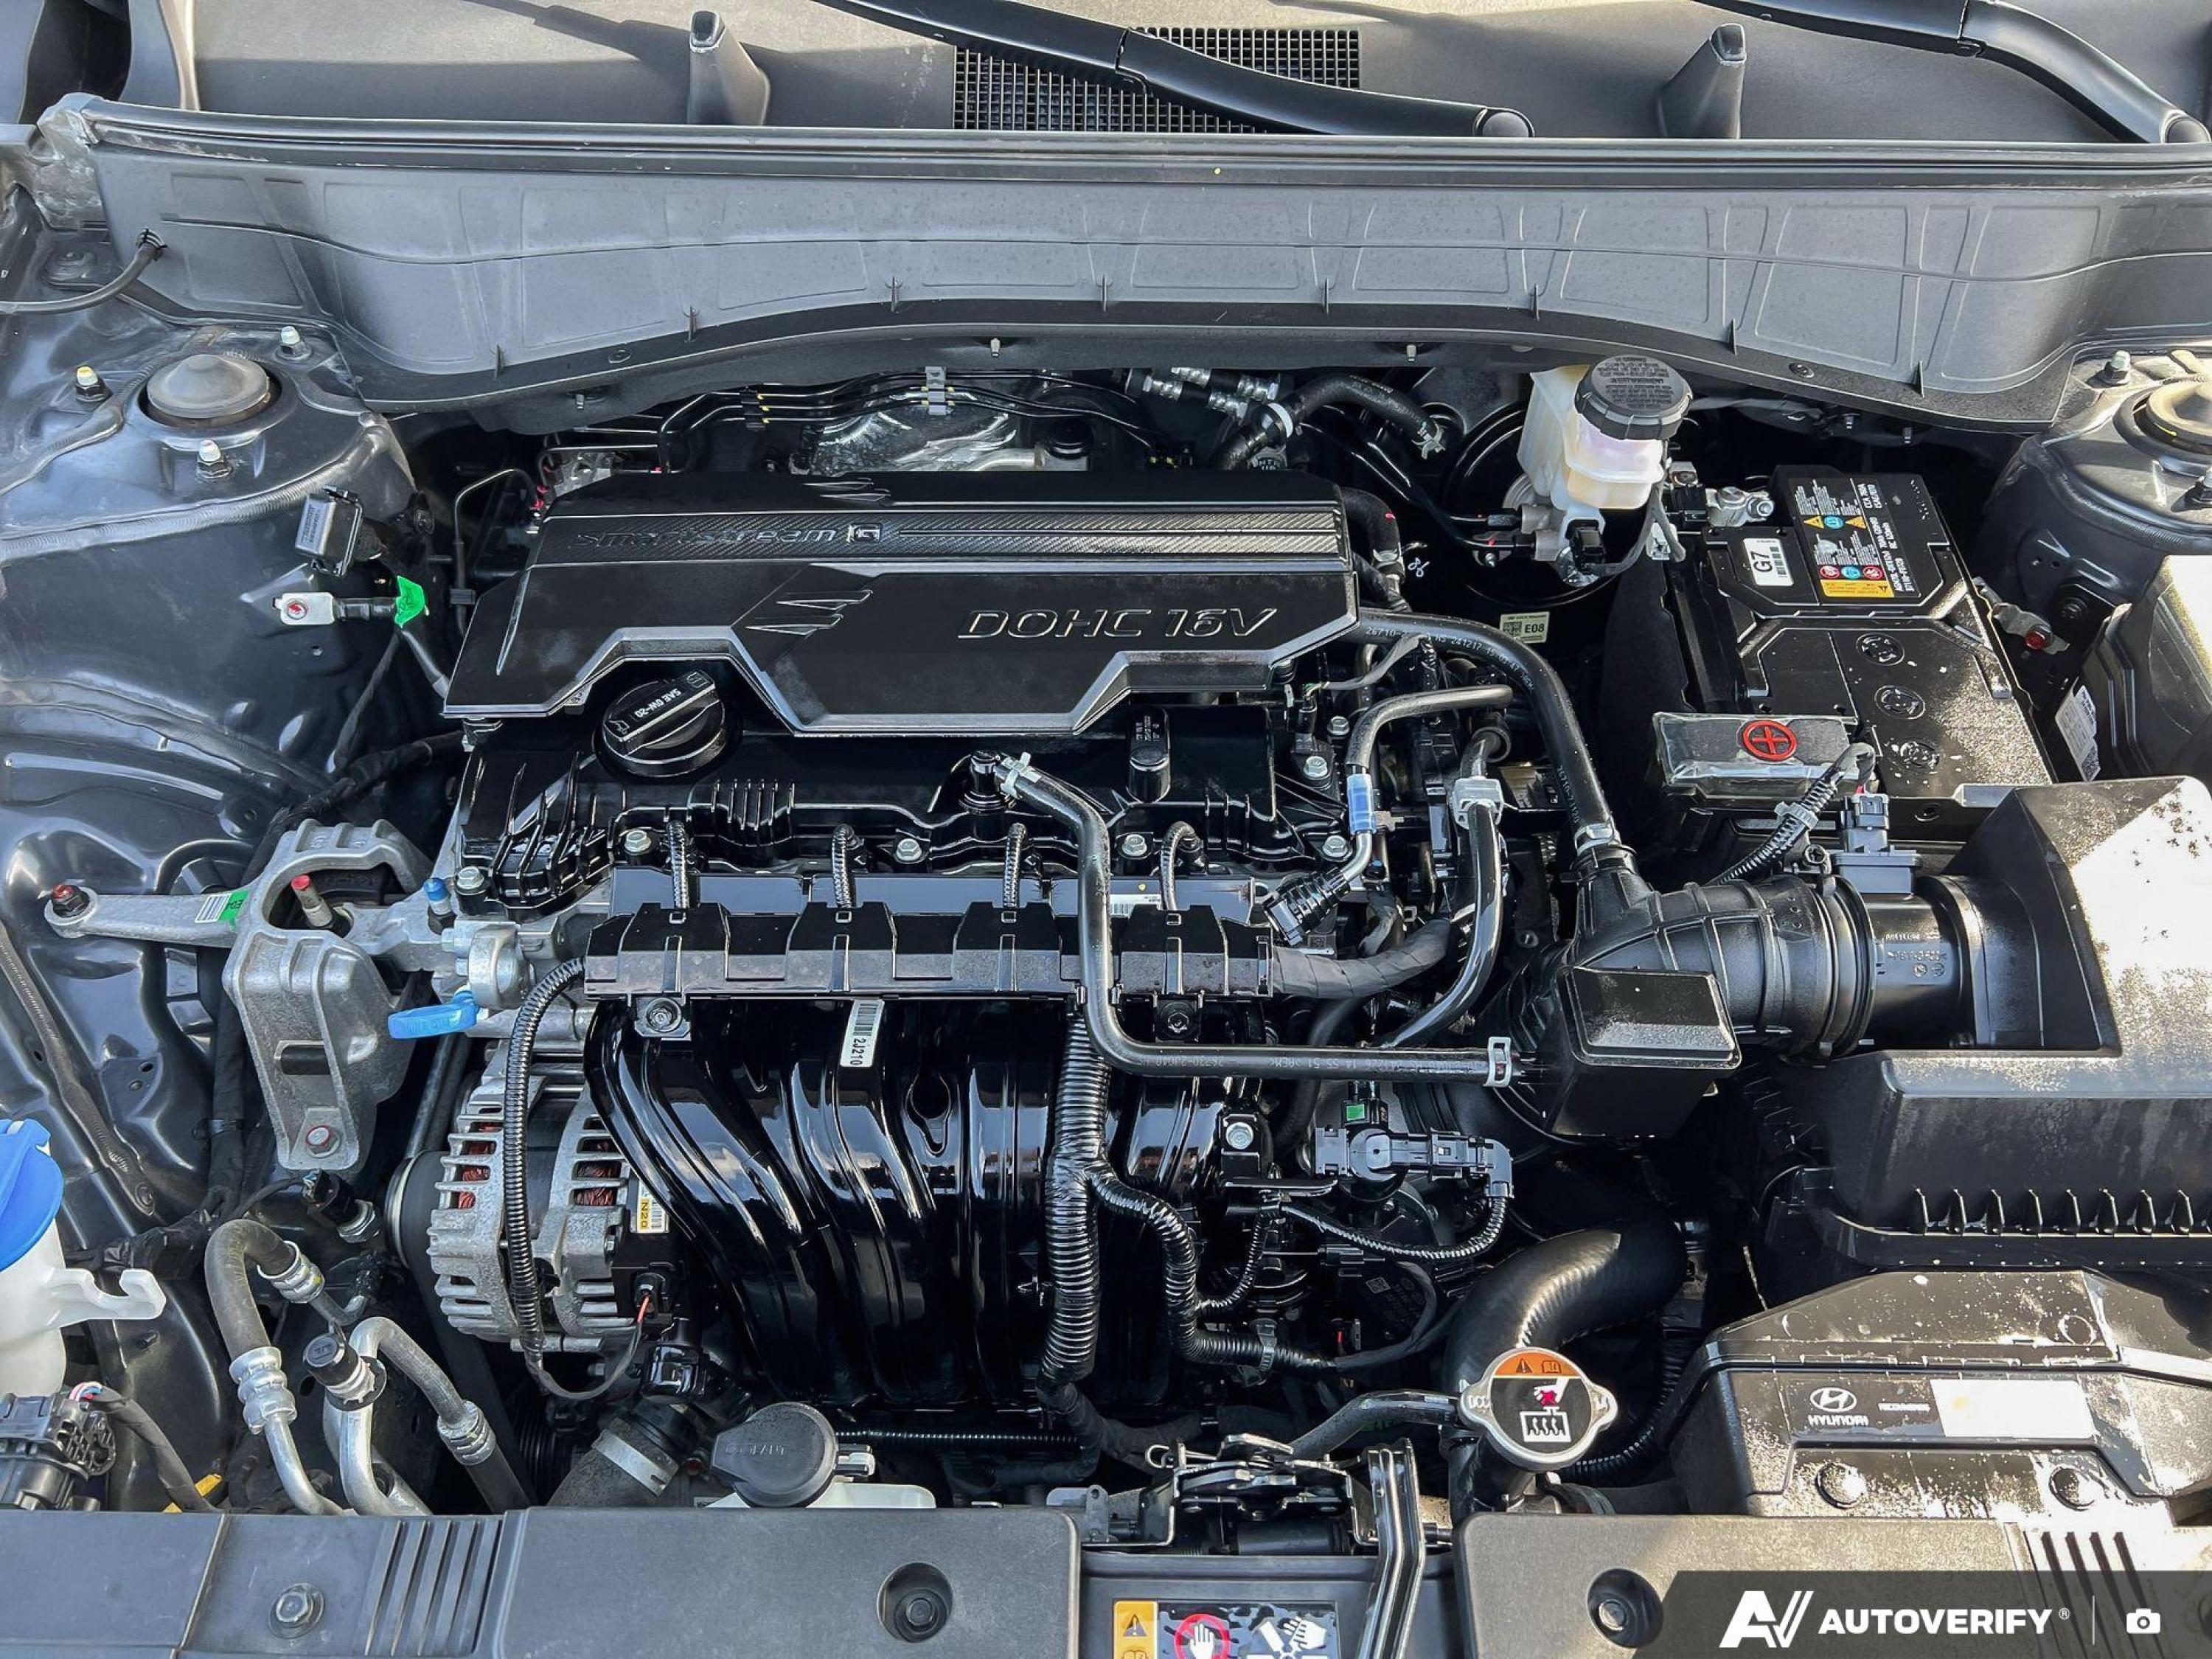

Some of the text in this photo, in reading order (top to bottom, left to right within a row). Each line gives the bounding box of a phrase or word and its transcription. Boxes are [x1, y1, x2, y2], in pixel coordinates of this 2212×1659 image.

[1750, 551, 1773, 571] G7
[958, 608, 1278, 639] DOHC 16V
[1525, 623, 1545, 633] E08
[635, 687, 682, 719] SAE 0W-20
[850, 1038, 867, 1065] 2J210
[1808, 1415, 1869, 1426] HYUNDAI
